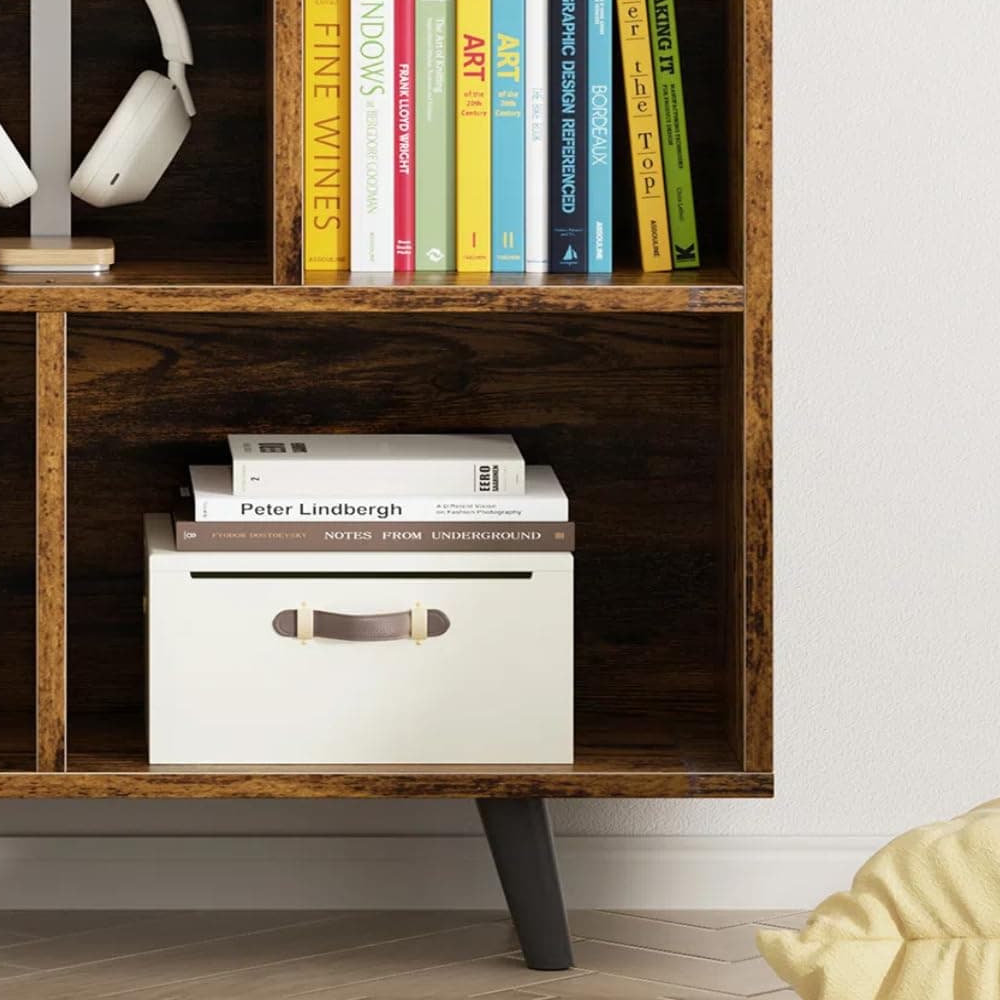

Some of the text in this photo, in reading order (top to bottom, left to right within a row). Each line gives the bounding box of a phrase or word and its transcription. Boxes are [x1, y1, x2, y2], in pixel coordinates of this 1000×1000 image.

[314, 23, 341, 98] FINE
[463, 33, 485, 81] ART
[496, 33, 520, 82] ART
[659, 56, 675, 75] IT
[561, 60, 576, 113] DESIGN
[398, 63, 410, 174] FRANK LLOYD WRIGHT
[591, 85, 607, 166] BORDEAUX
[313, 115, 341, 231] WINES
[561, 118, 576, 213] REFERENCED
[479, 465, 491, 492] EERO
[241, 502, 403, 519] Peter Lindbergh
[324, 530, 542, 541] NOTES FROM UNDERGROUND
